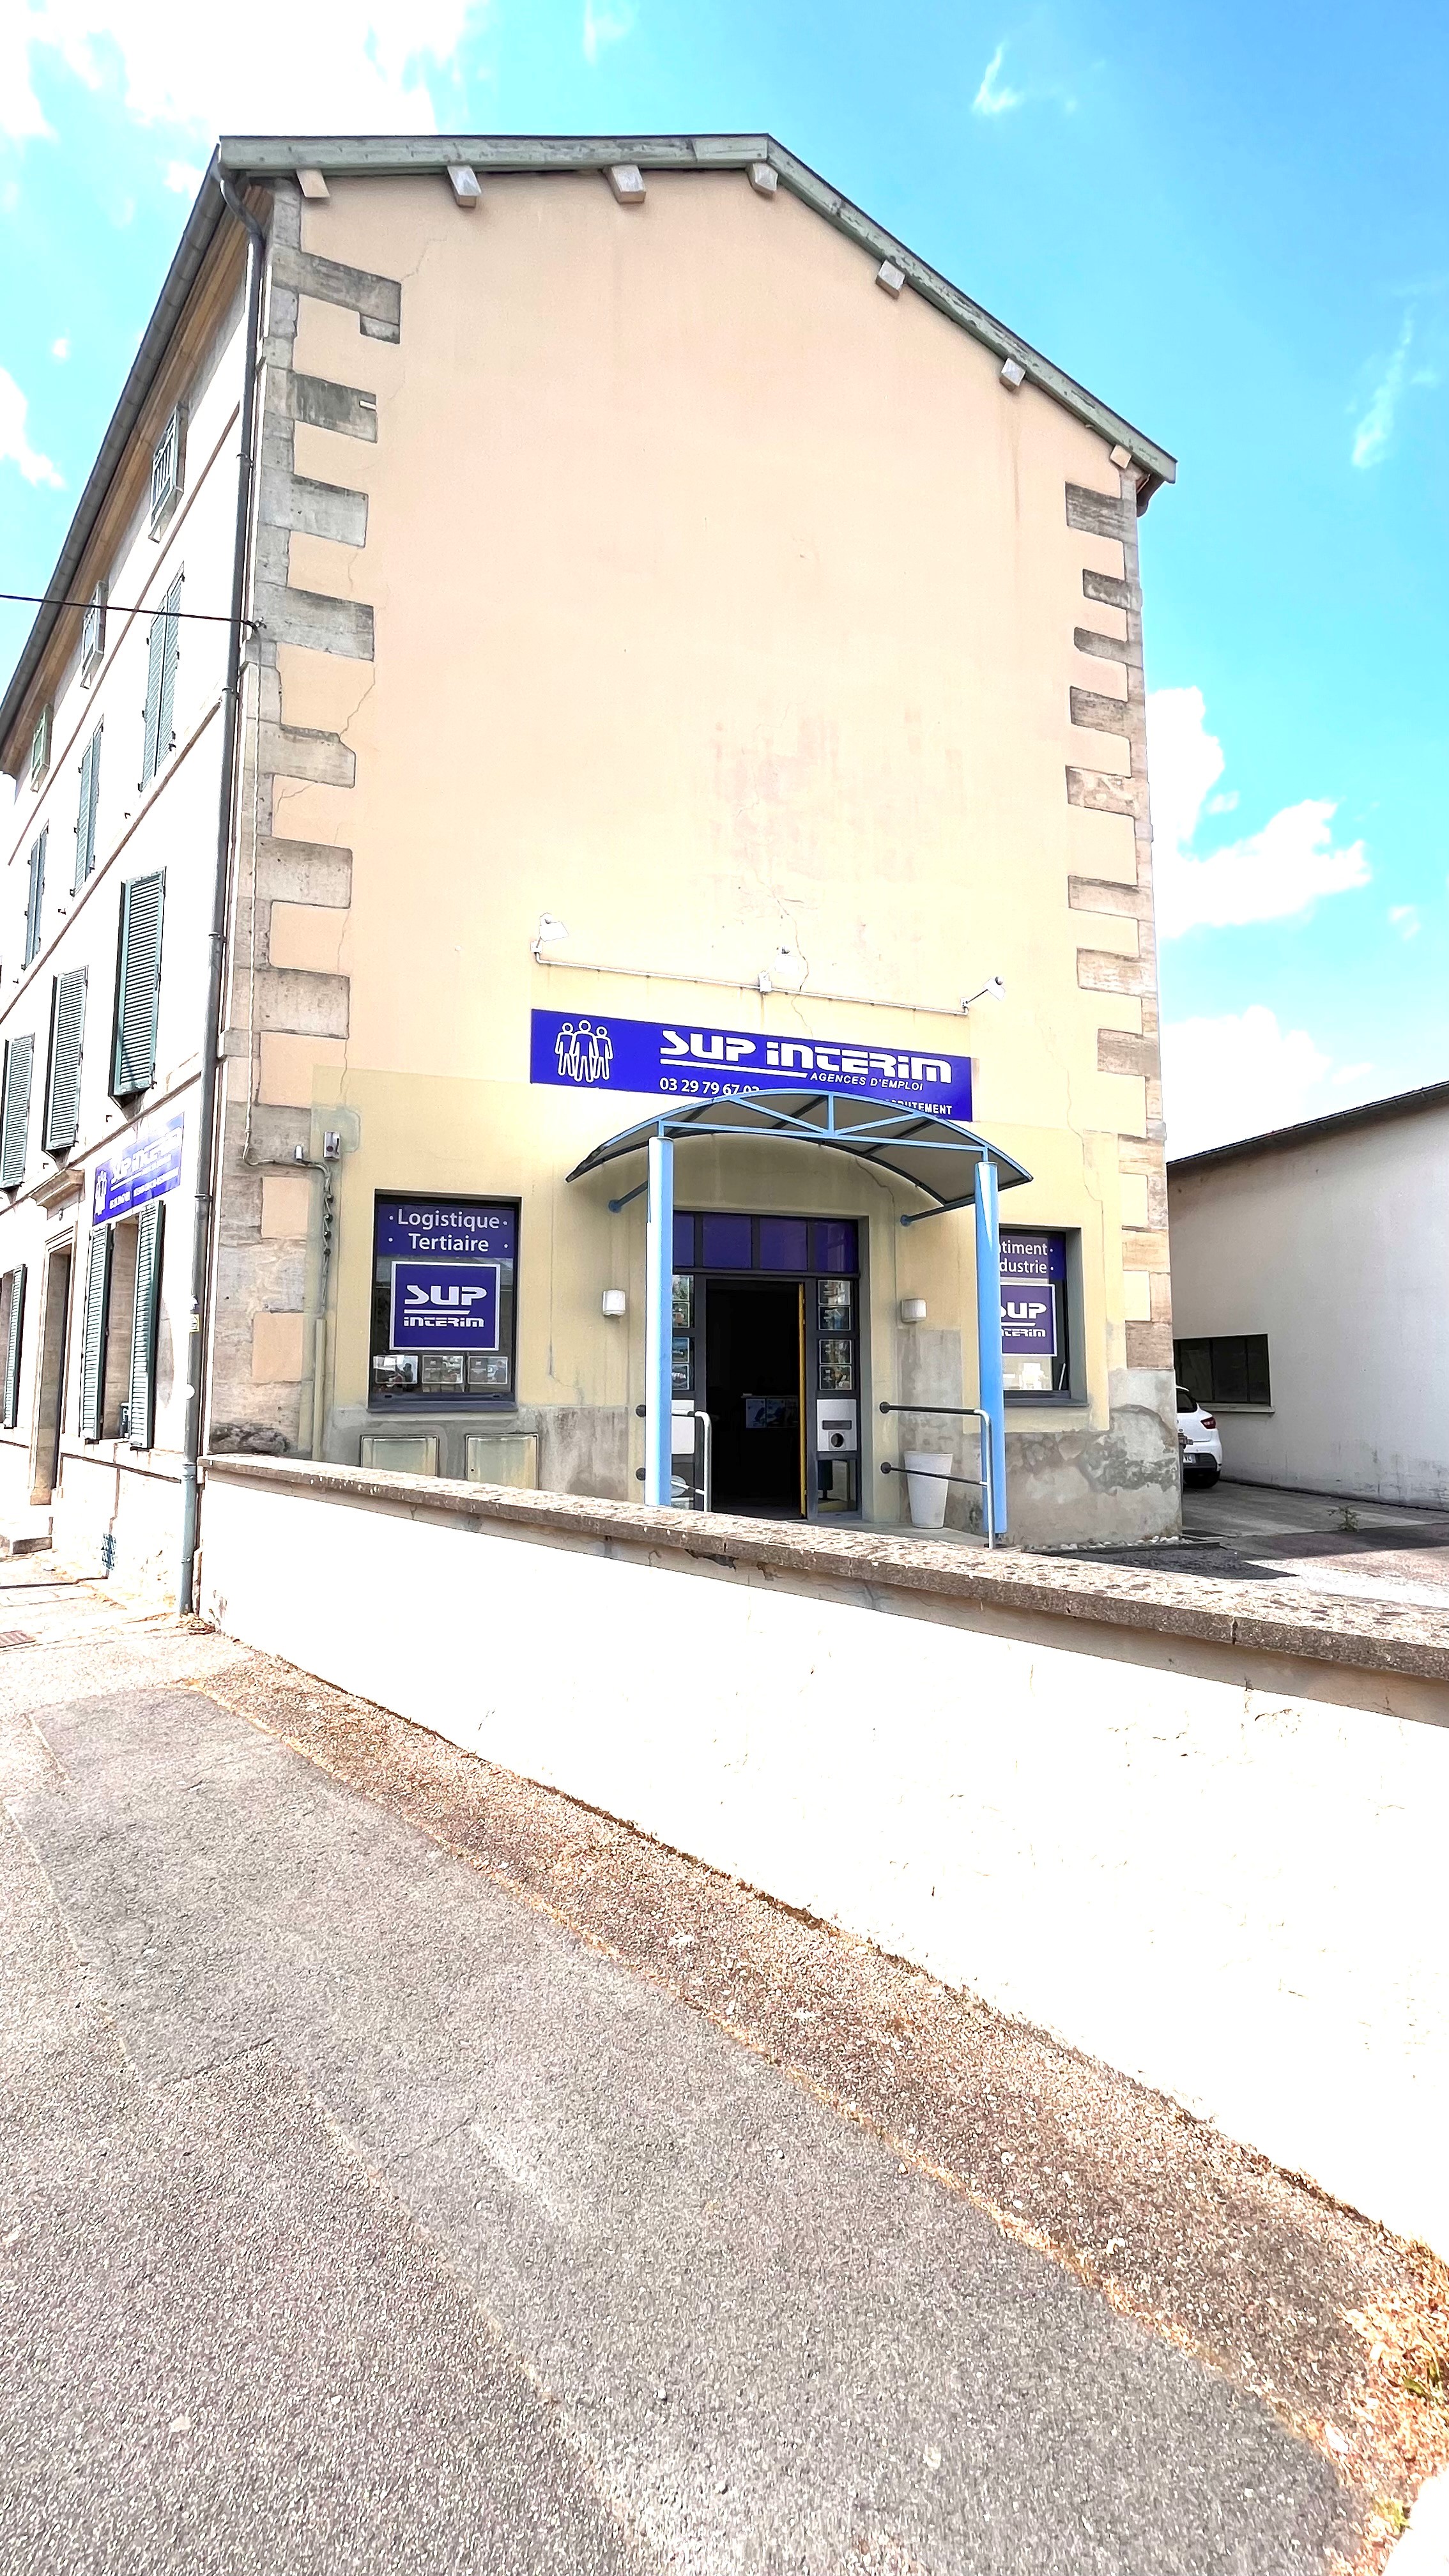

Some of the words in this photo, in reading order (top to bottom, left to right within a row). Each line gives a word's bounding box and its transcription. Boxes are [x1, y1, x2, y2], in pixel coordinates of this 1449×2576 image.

[660, 1030, 756, 1062] SUP
[659, 1077, 678, 1091] 03
[681, 1079, 699, 1092] 29
[702, 1081, 720, 1095] 79
[722, 1084, 740, 1096] 67
[810, 1073, 866, 1085] AGENCES
[870, 1078, 923, 1091] D'EMPLOI
[397, 1208, 500, 1232] Logistique
[408, 1233, 489, 1252] Tertiaire
[999, 1239, 1048, 1255] timent
[999, 1257, 1047, 1273] dustrie
[404, 1285, 487, 1306] SUP
